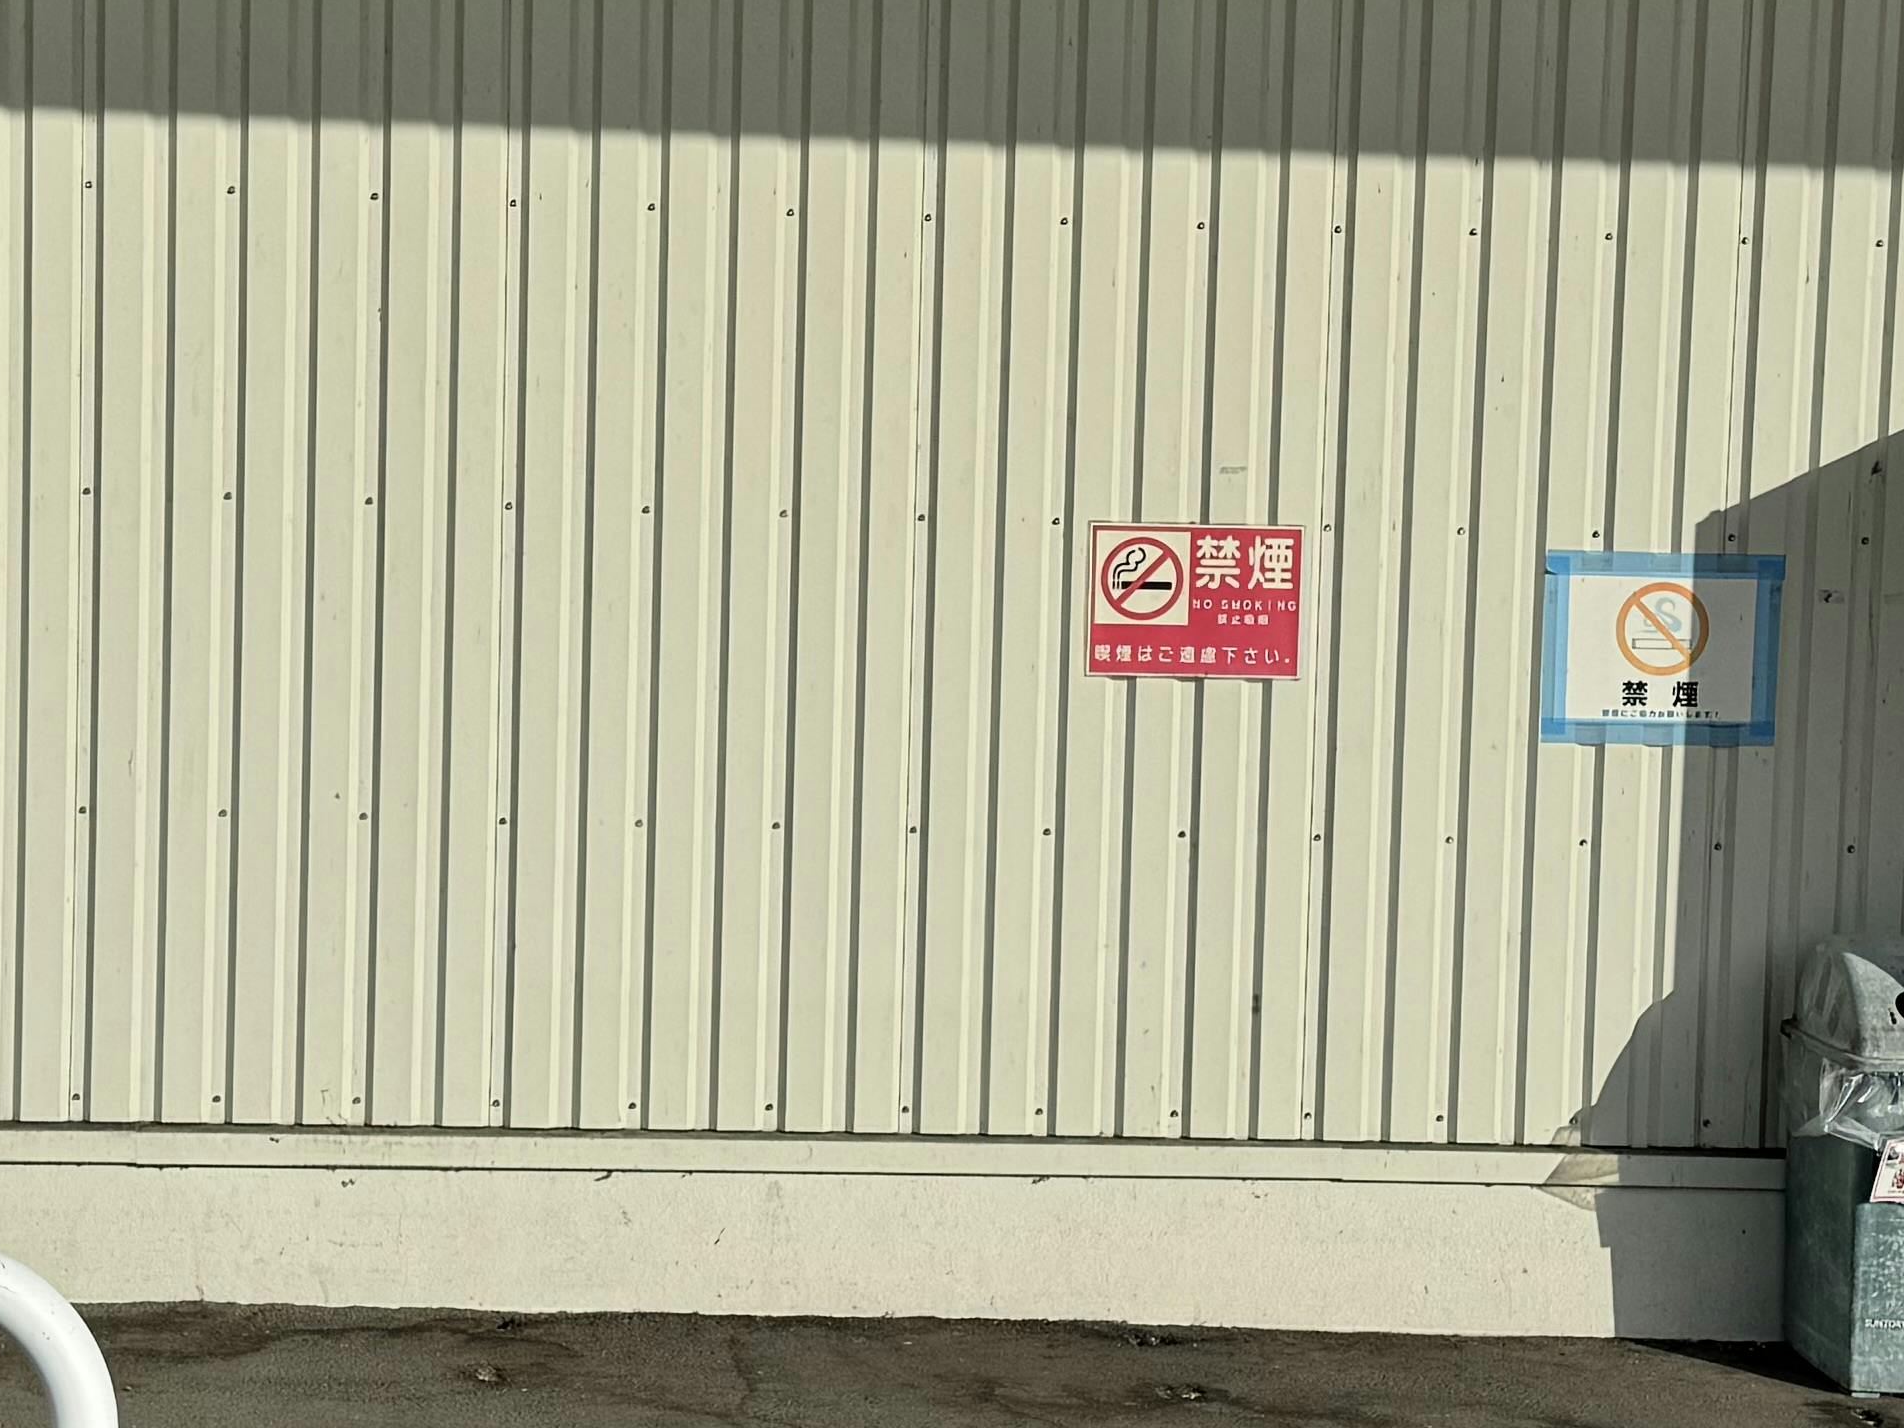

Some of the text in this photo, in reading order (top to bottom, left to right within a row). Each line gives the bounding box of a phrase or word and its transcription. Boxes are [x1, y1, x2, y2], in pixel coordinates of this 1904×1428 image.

[1195, 534, 1295, 590] 禁煙
[1192, 598, 1298, 612] NO SMOKING
